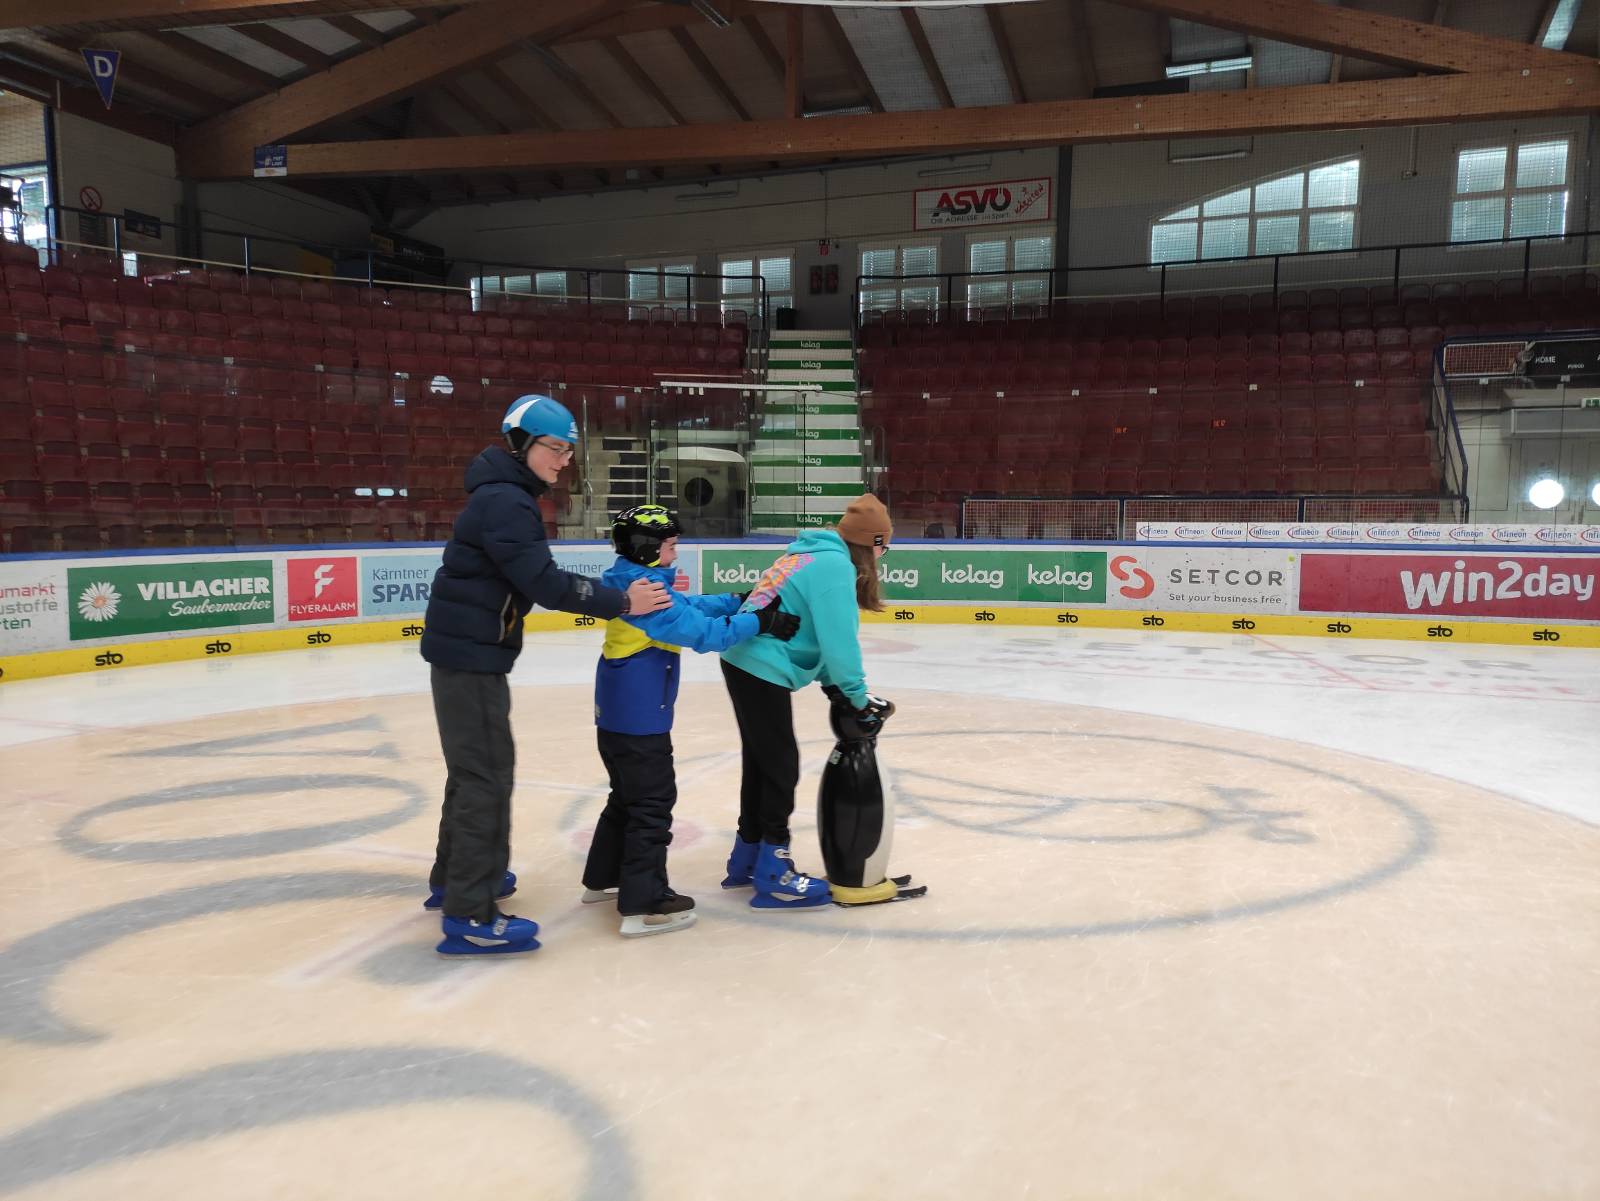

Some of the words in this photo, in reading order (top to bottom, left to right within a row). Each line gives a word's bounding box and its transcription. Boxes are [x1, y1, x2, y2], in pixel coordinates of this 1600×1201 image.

[93, 56, 113, 77] D
[1535, 355, 1556, 364] HOME
[796, 513, 823, 525] kelag
[1215, 527, 1242, 537] infineon
[1496, 528, 1527, 539] infineon
[372, 567, 430, 581] Kärntner
[941, 562, 1004, 588] kelag
[1027, 563, 1093, 591] kelag
[1169, 568, 1283, 587] SETCOR
[136, 577, 271, 601] VILLACHER
[1400, 560, 1595, 610] win2day
[1169, 592, 1185, 601] Set
[1188, 595, 1210, 603] your
[1214, 594, 1258, 604] business
[1261, 595, 1282, 604] free
[168, 595, 272, 617] Saubermacher
[290, 601, 356, 614] FLYERALARM
[574, 615, 596, 626] sto
[895, 609, 915, 620] sto
[975, 610, 996, 622] sto
[1057, 612, 1079, 624] sto
[1142, 615, 1165, 626] sto
[401, 624, 424, 637] sto
[1232, 618, 1256, 630] sto
[1327, 621, 1352, 634] sto
[307, 631, 332, 644] sto
[1427, 624, 1453, 638] sto
[1532, 629, 1560, 642] sto
[205, 640, 232, 655] sto
[94, 651, 124, 667] sto
